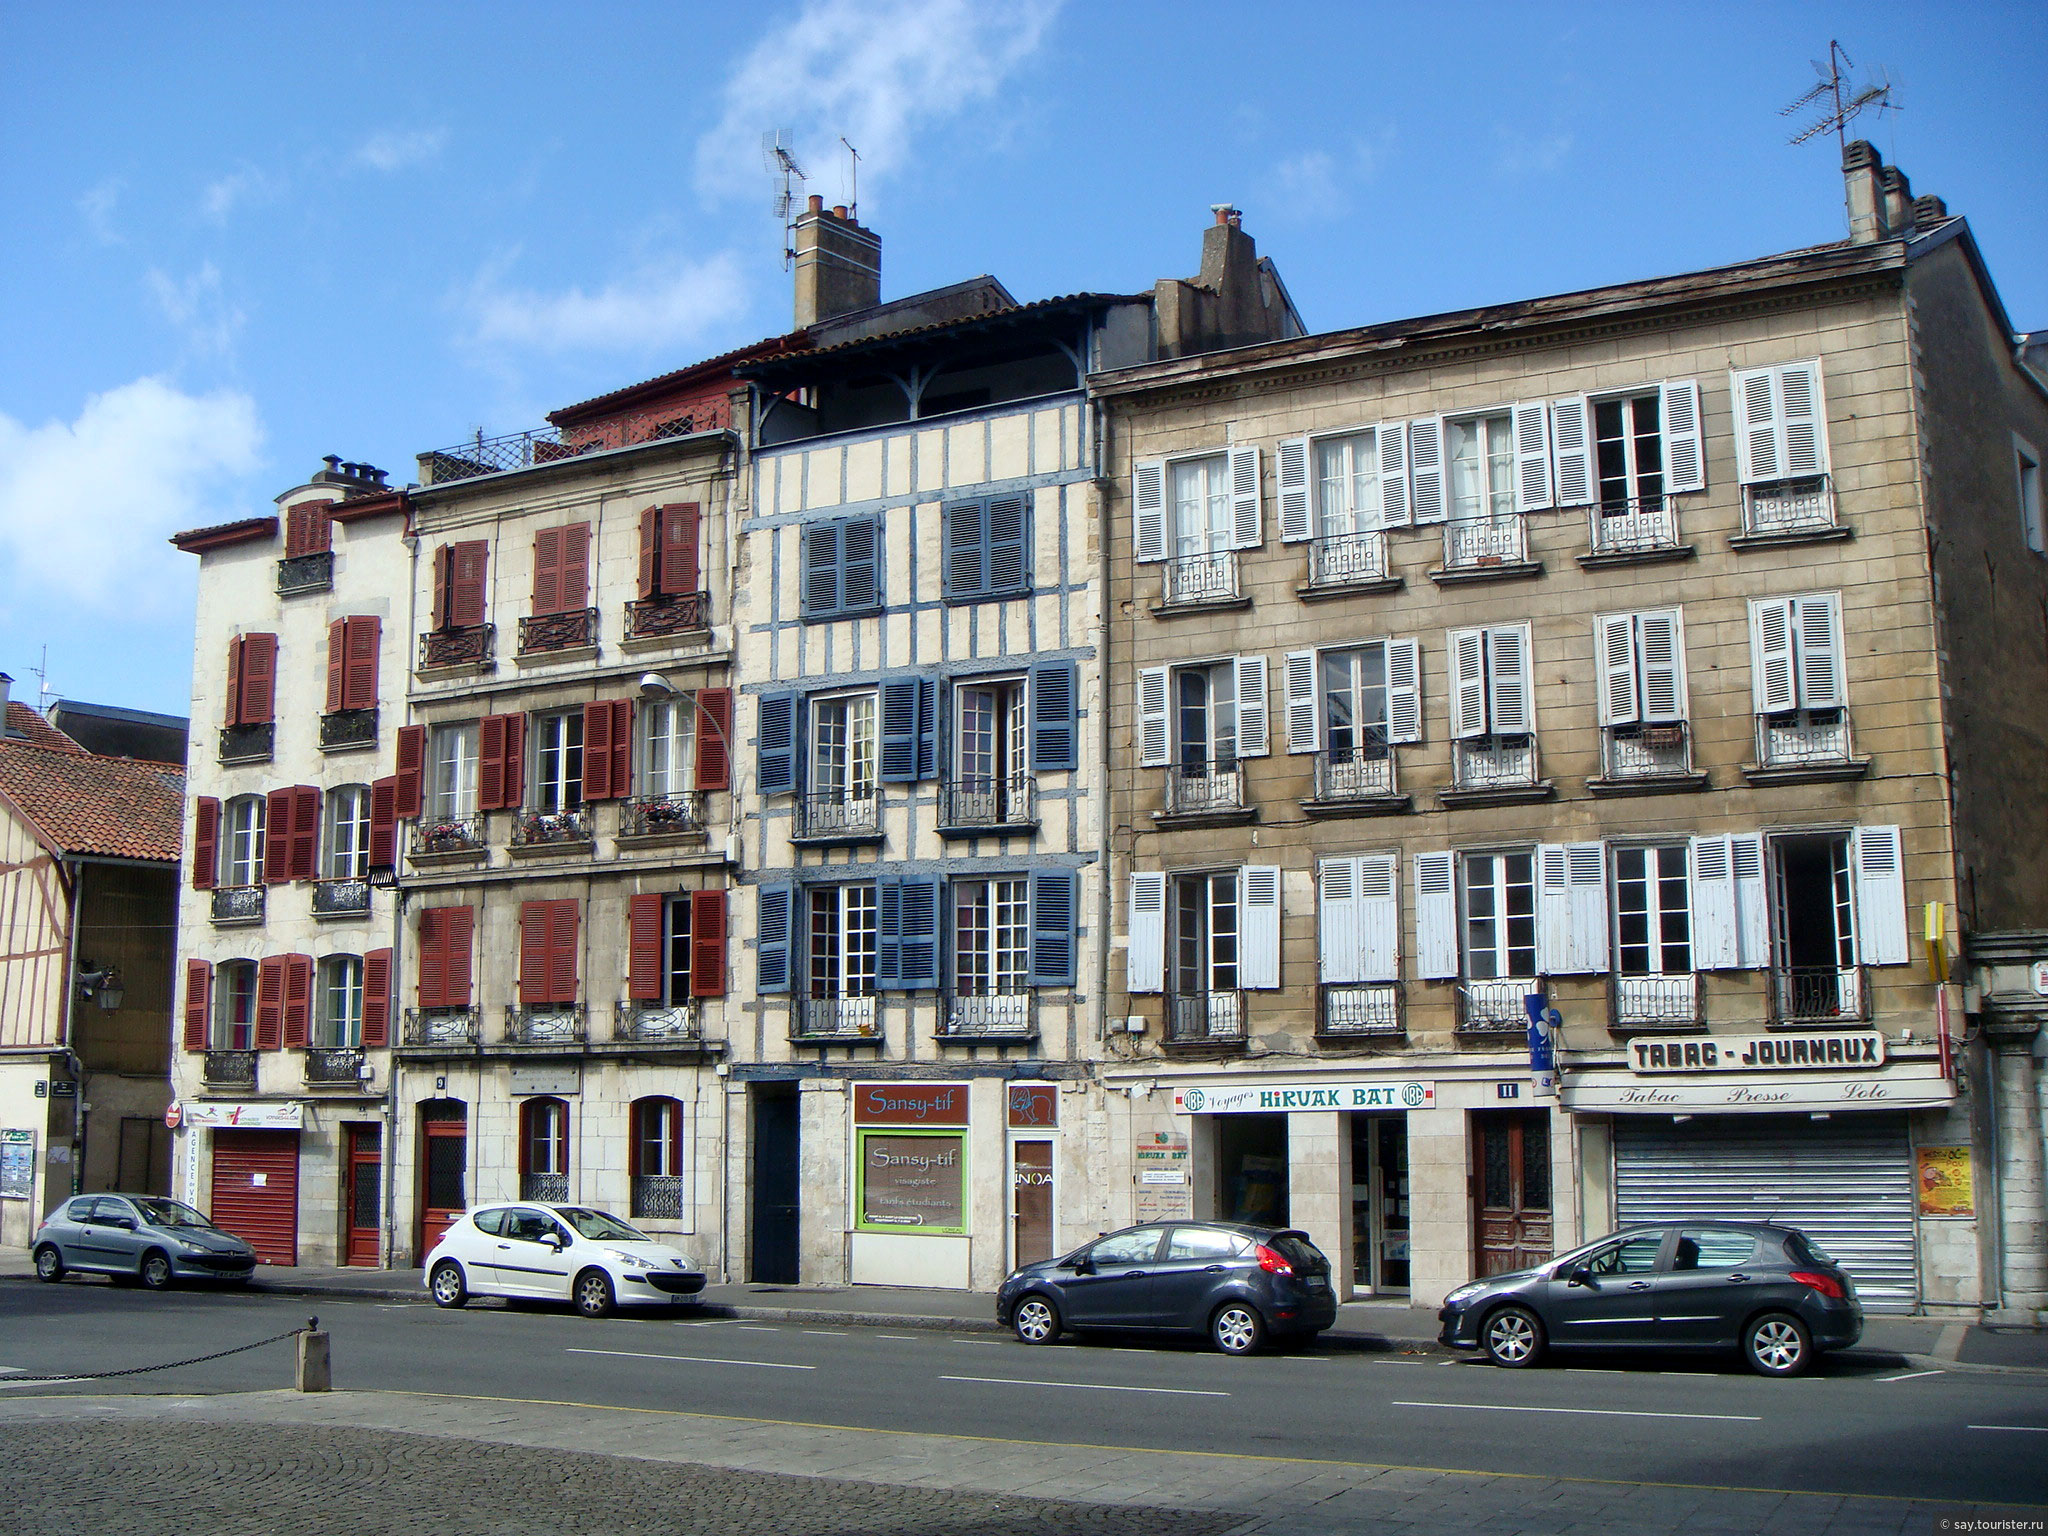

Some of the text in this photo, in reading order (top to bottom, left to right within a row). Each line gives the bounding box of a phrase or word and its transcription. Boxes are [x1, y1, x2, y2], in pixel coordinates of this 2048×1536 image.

[1634, 1042, 1718, 1068] TABAC
[1742, 1037, 1879, 1066] JOURNAUX
[437, 1078, 444, 1088] 9
[1619, 1082, 1891, 1104] Tabac Presse Loto
[867, 1089, 955, 1118] Sansy-tif
[1209, 1090, 1254, 1110] Voyages
[1352, 1087, 1395, 1106] BAT
[871, 1147, 956, 1172] Sansy-tif
[894, 1176, 936, 1187] visagiste
